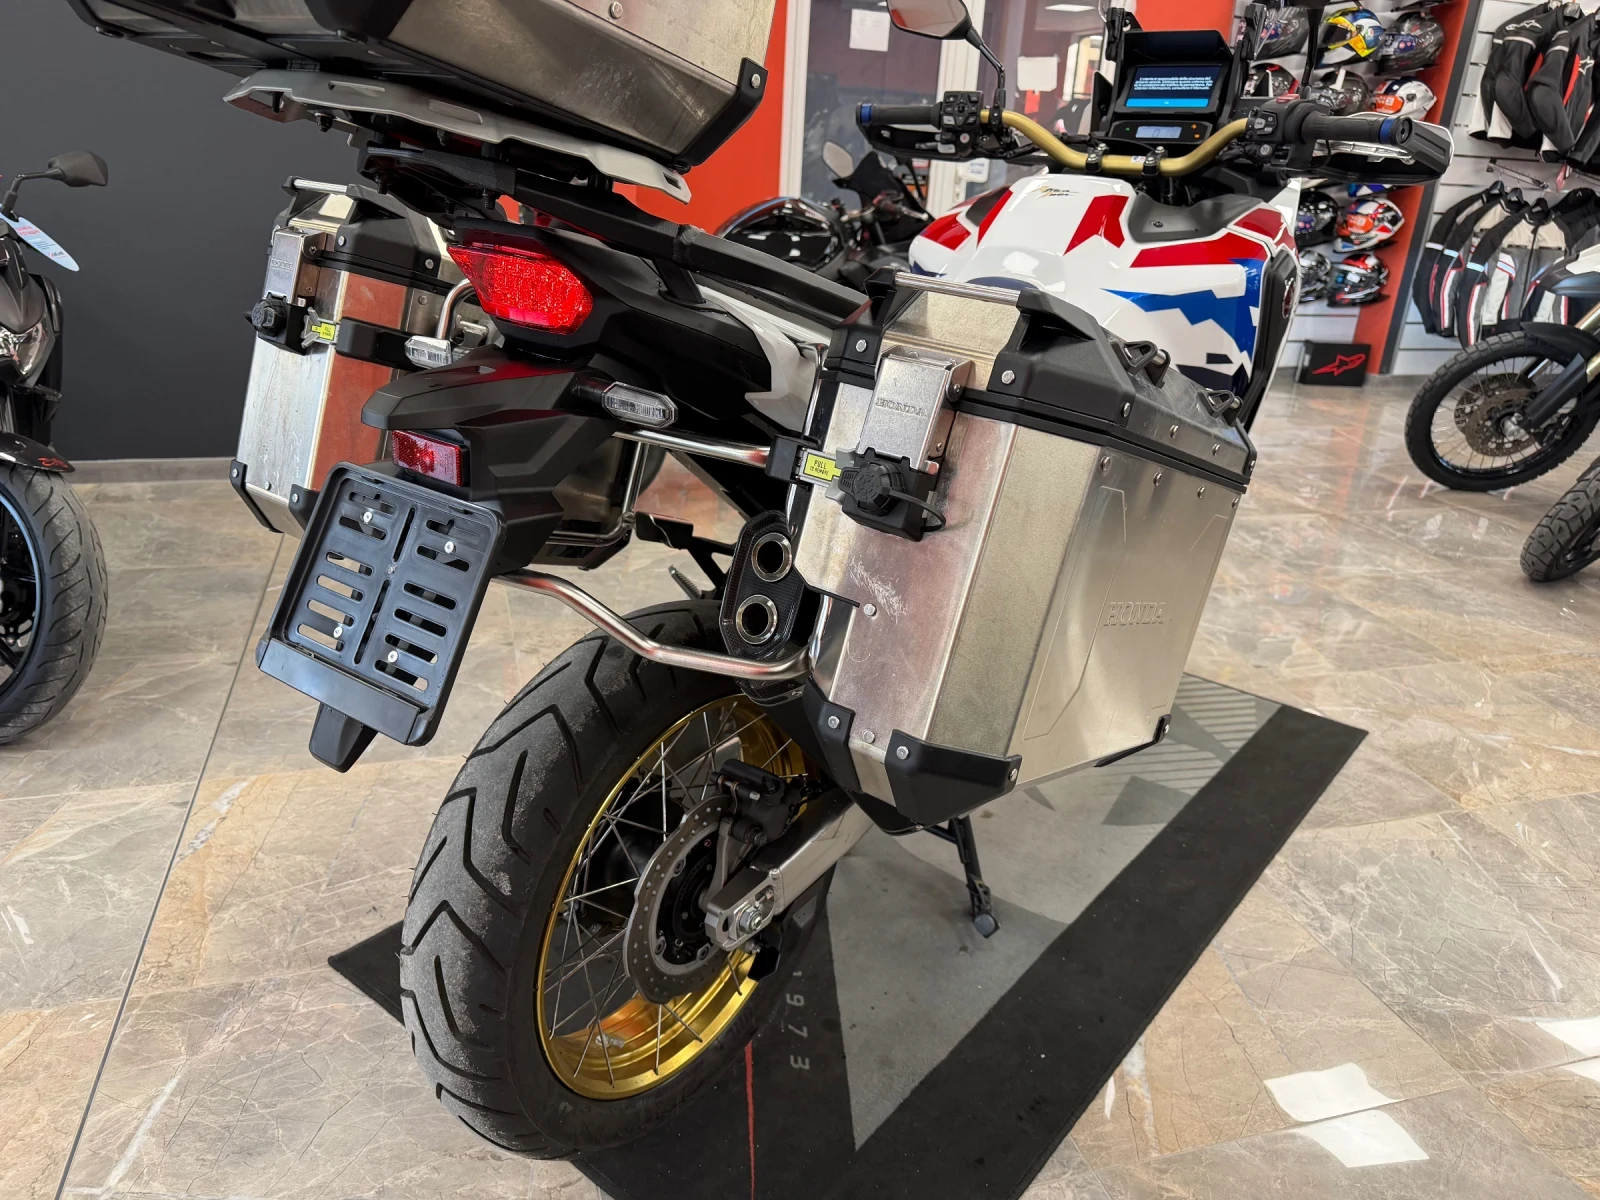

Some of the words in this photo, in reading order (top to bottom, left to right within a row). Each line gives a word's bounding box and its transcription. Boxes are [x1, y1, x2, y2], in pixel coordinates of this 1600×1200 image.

[875, 397, 928, 416] HONDA
[813, 459, 827, 470] PULL
[1103, 601, 1167, 626] HONDA
